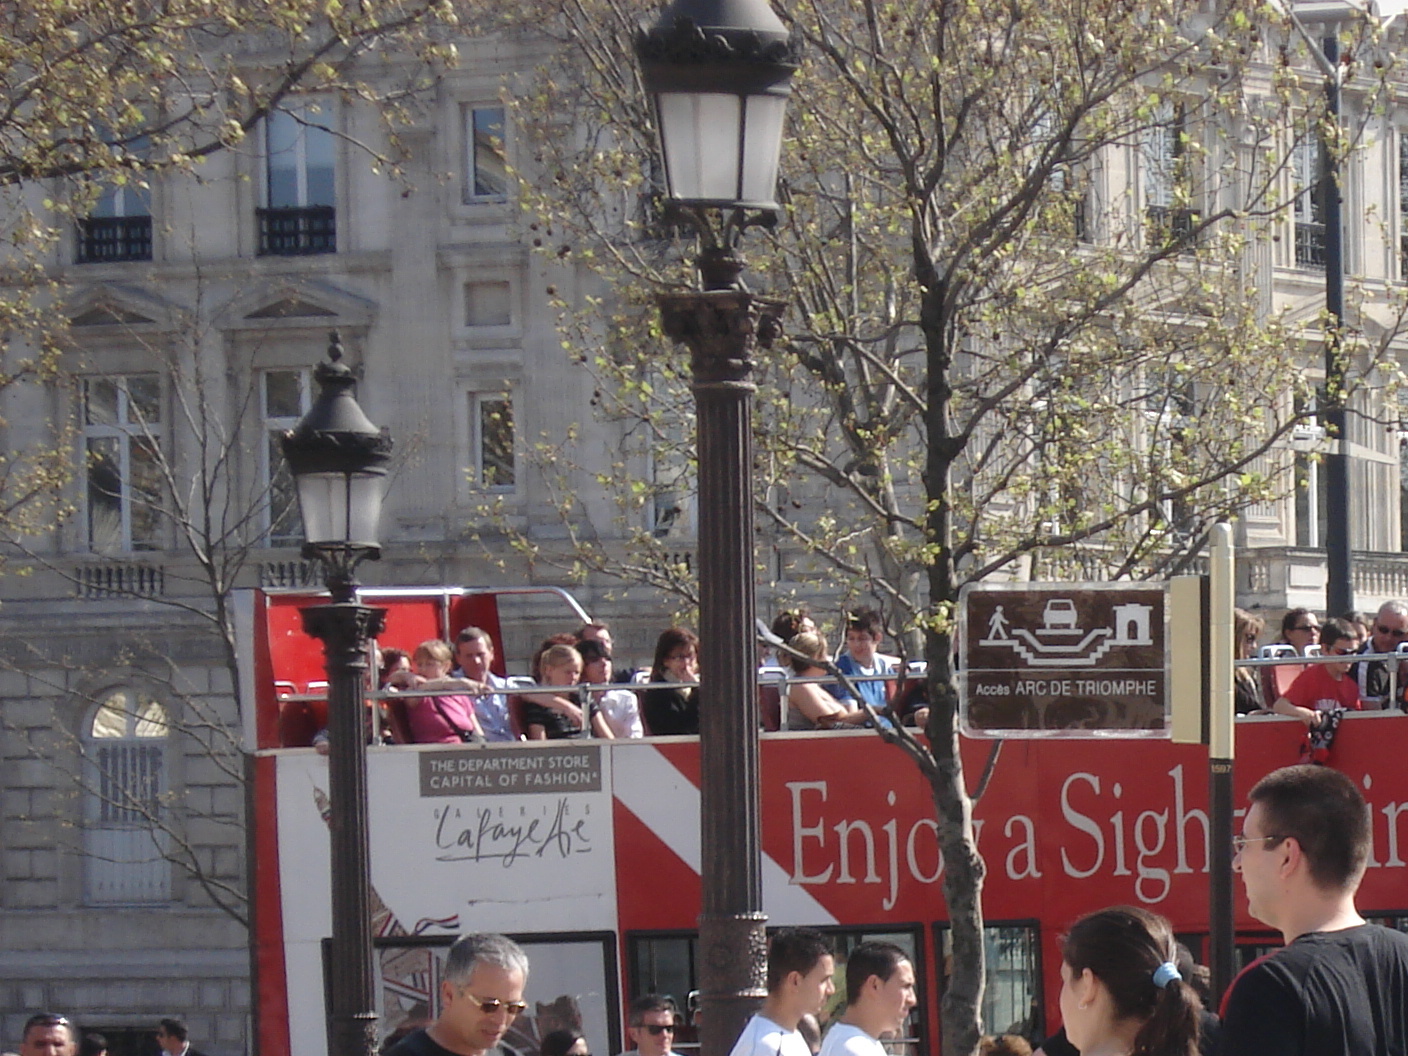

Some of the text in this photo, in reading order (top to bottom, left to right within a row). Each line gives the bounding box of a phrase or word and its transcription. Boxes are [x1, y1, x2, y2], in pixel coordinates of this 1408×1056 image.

[976, 679, 1157, 696] Accès ARC DE TRIOMPHE
[430, 754, 590, 773] THE DEPARTMENT STORE
[430, 774, 493, 790] CAPITAL
[498, 773, 519, 787] OF
[785, 780, 985, 911] Enjo
[1004, 815, 1042, 880] a
